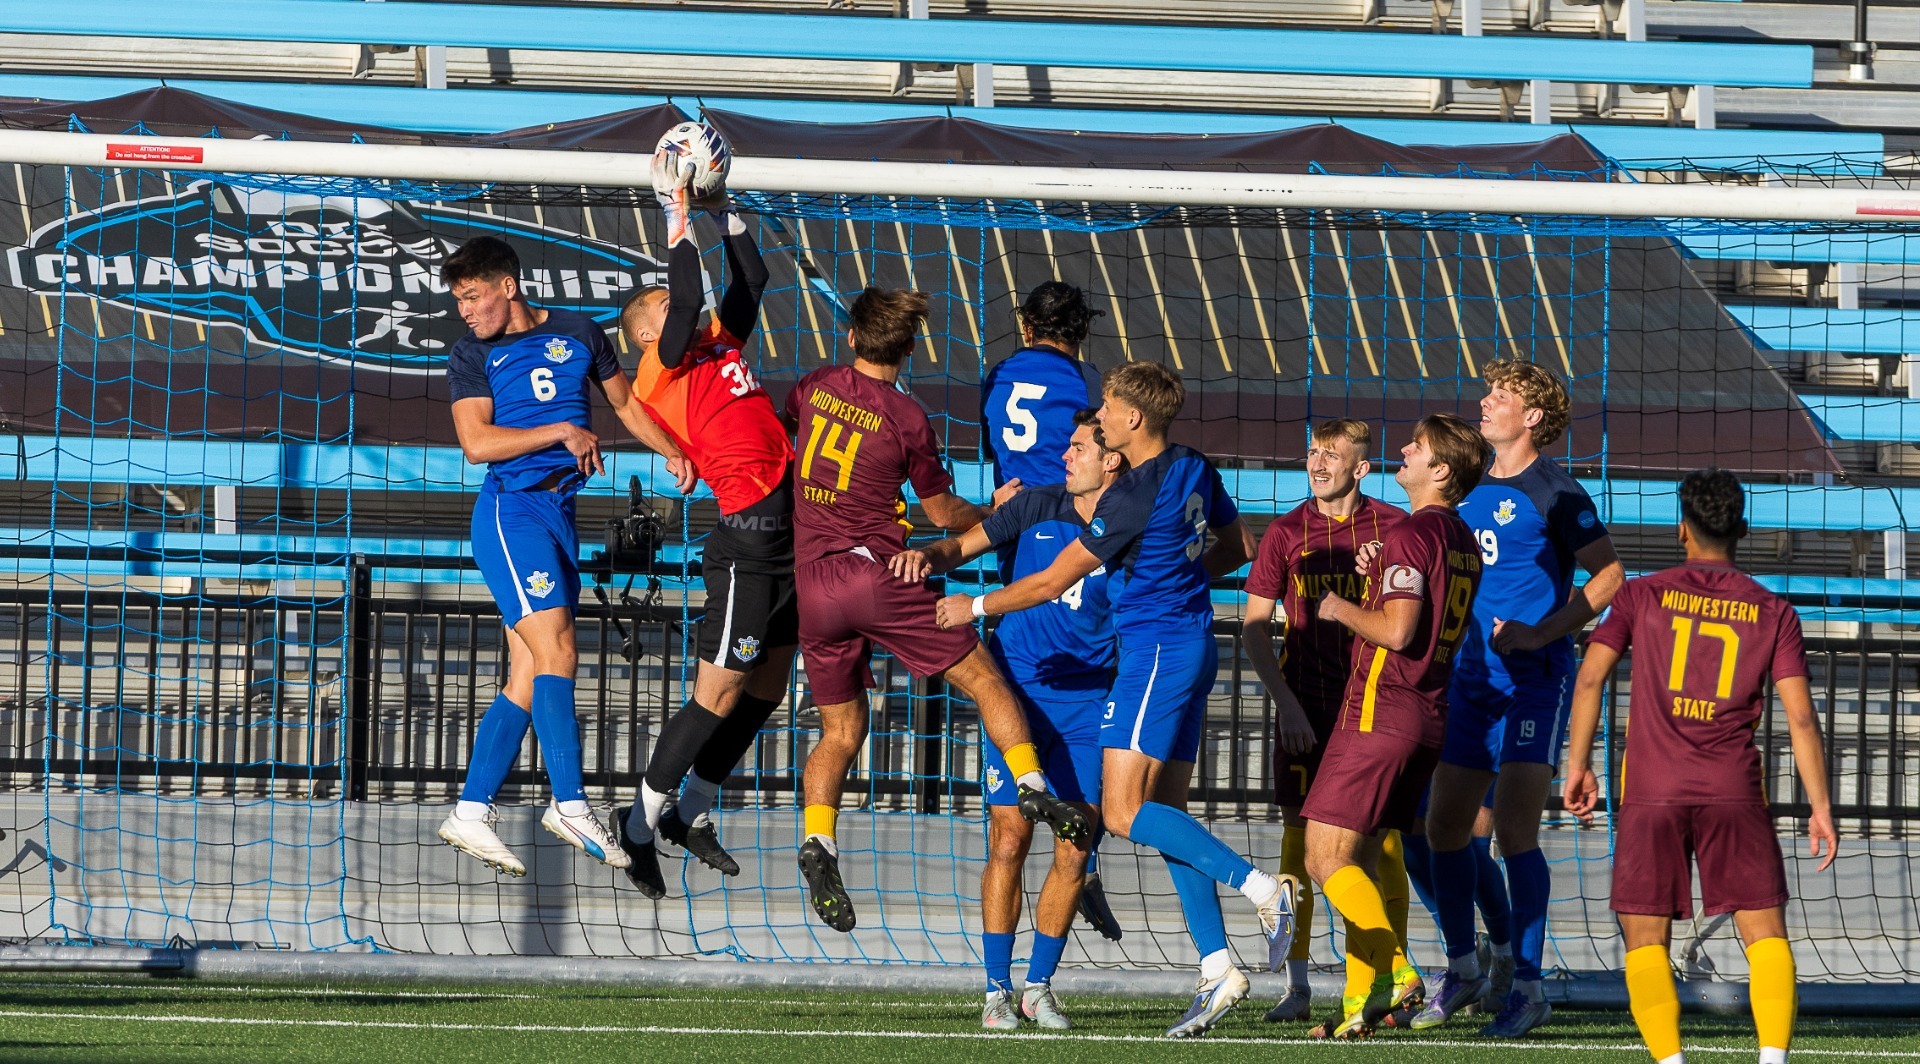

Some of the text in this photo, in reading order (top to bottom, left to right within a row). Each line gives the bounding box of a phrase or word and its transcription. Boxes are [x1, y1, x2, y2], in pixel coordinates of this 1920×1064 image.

[530, 367, 557, 402] 6
[809, 387, 883, 433] MIDWESTERN
[1002, 382, 1047, 453] 5
[800, 413, 863, 492] 14
[1185, 491, 1207, 562] 3
[1439, 574, 1472, 642] 19
[1661, 589, 1759, 623] MIDWESTERN
[1668, 615, 1740, 699] 17
[1103, 701, 1116, 719] 3
[1672, 696, 1717, 721] STATE
[1520, 720, 1536, 738] 19
[1289, 763, 1309, 796] 7
